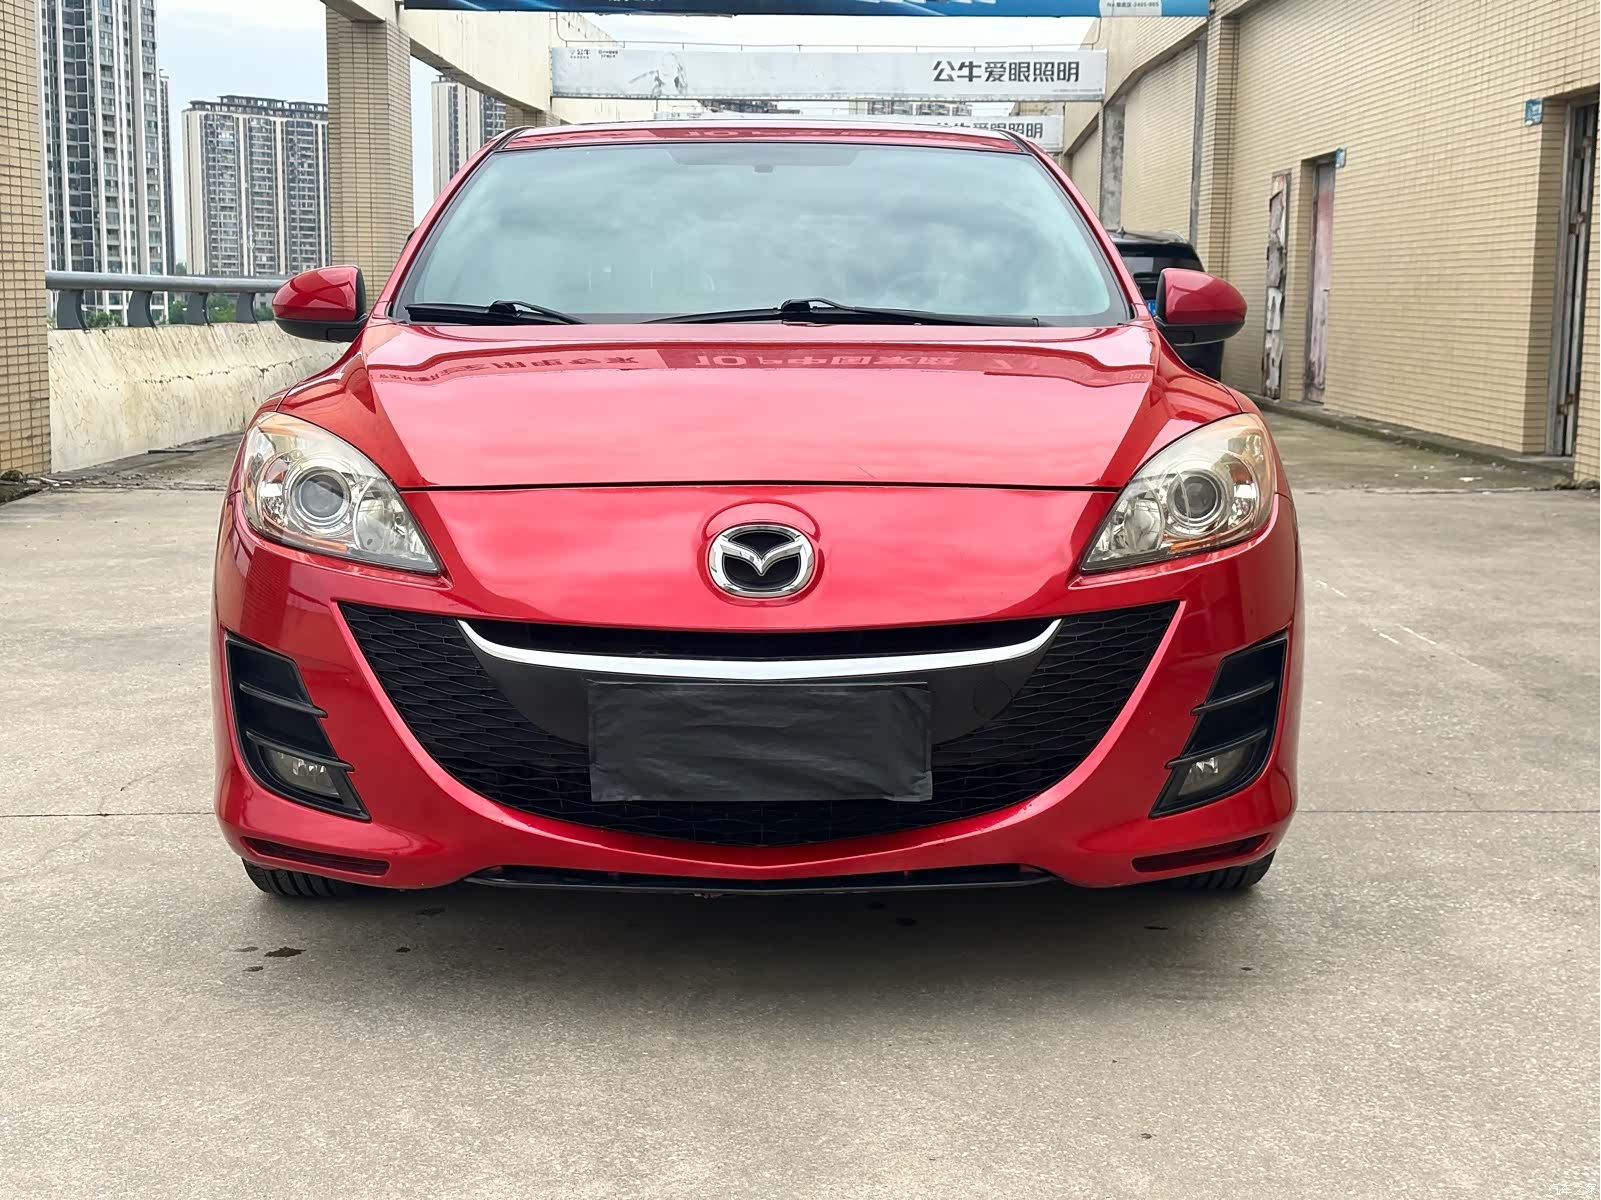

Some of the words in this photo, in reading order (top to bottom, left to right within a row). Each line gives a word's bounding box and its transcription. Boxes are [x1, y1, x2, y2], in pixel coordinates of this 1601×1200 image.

[932, 60, 1080, 82] 公牛爱眼照明
